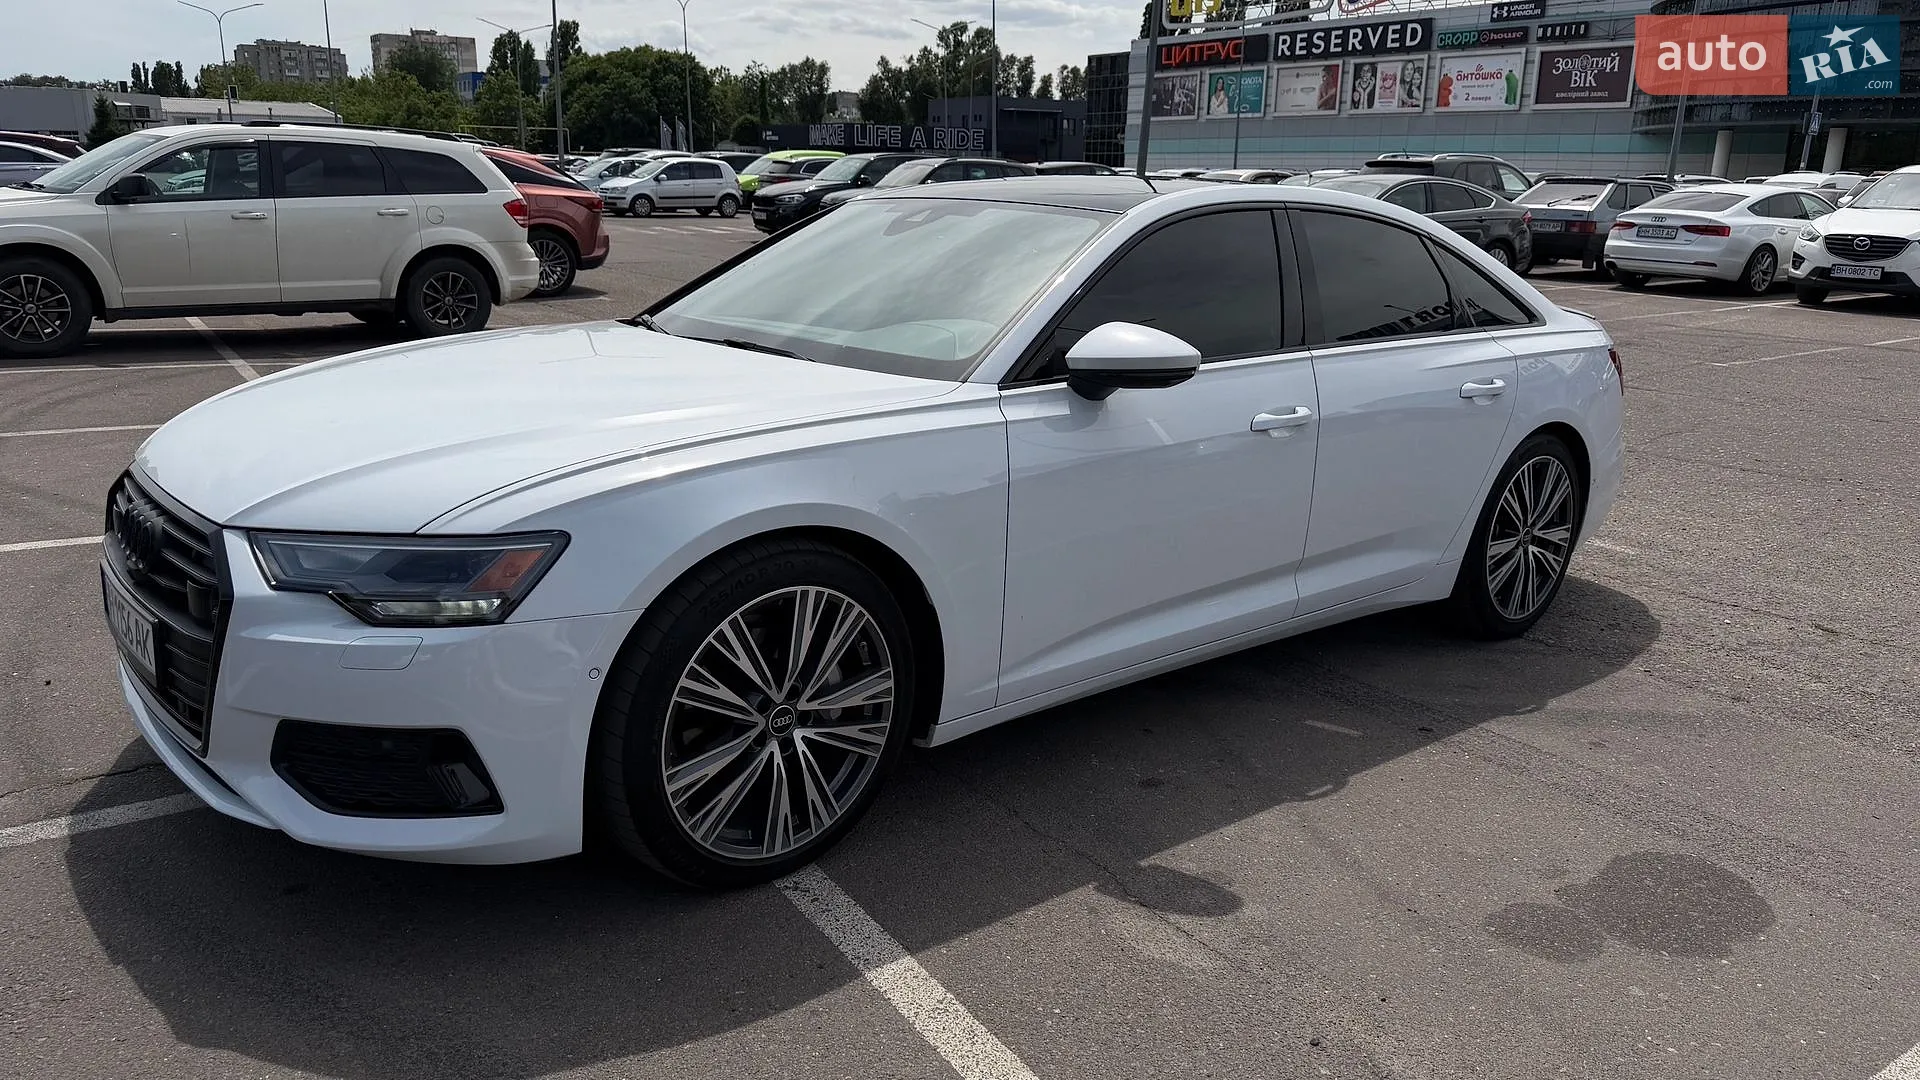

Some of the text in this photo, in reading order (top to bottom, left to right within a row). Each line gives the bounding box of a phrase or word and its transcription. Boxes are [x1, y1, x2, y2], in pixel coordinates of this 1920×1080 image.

[1509, 8, 1542, 17] ARMOUR
[1510, 3, 1535, 11] UNDER
[1277, 23, 1423, 57] RESERVED
[1437, 31, 1478, 46] CROPP
[1489, 31, 1524, 41] house
[1161, 39, 1245, 66] ЦИТРУС
[1464, 92, 1470, 101] 2
[809, 124, 985, 150] MAKE LIFE A RIDE
[1836, 266, 1879, 277] BH 0802 TC
[134, 616, 153, 667] AK
